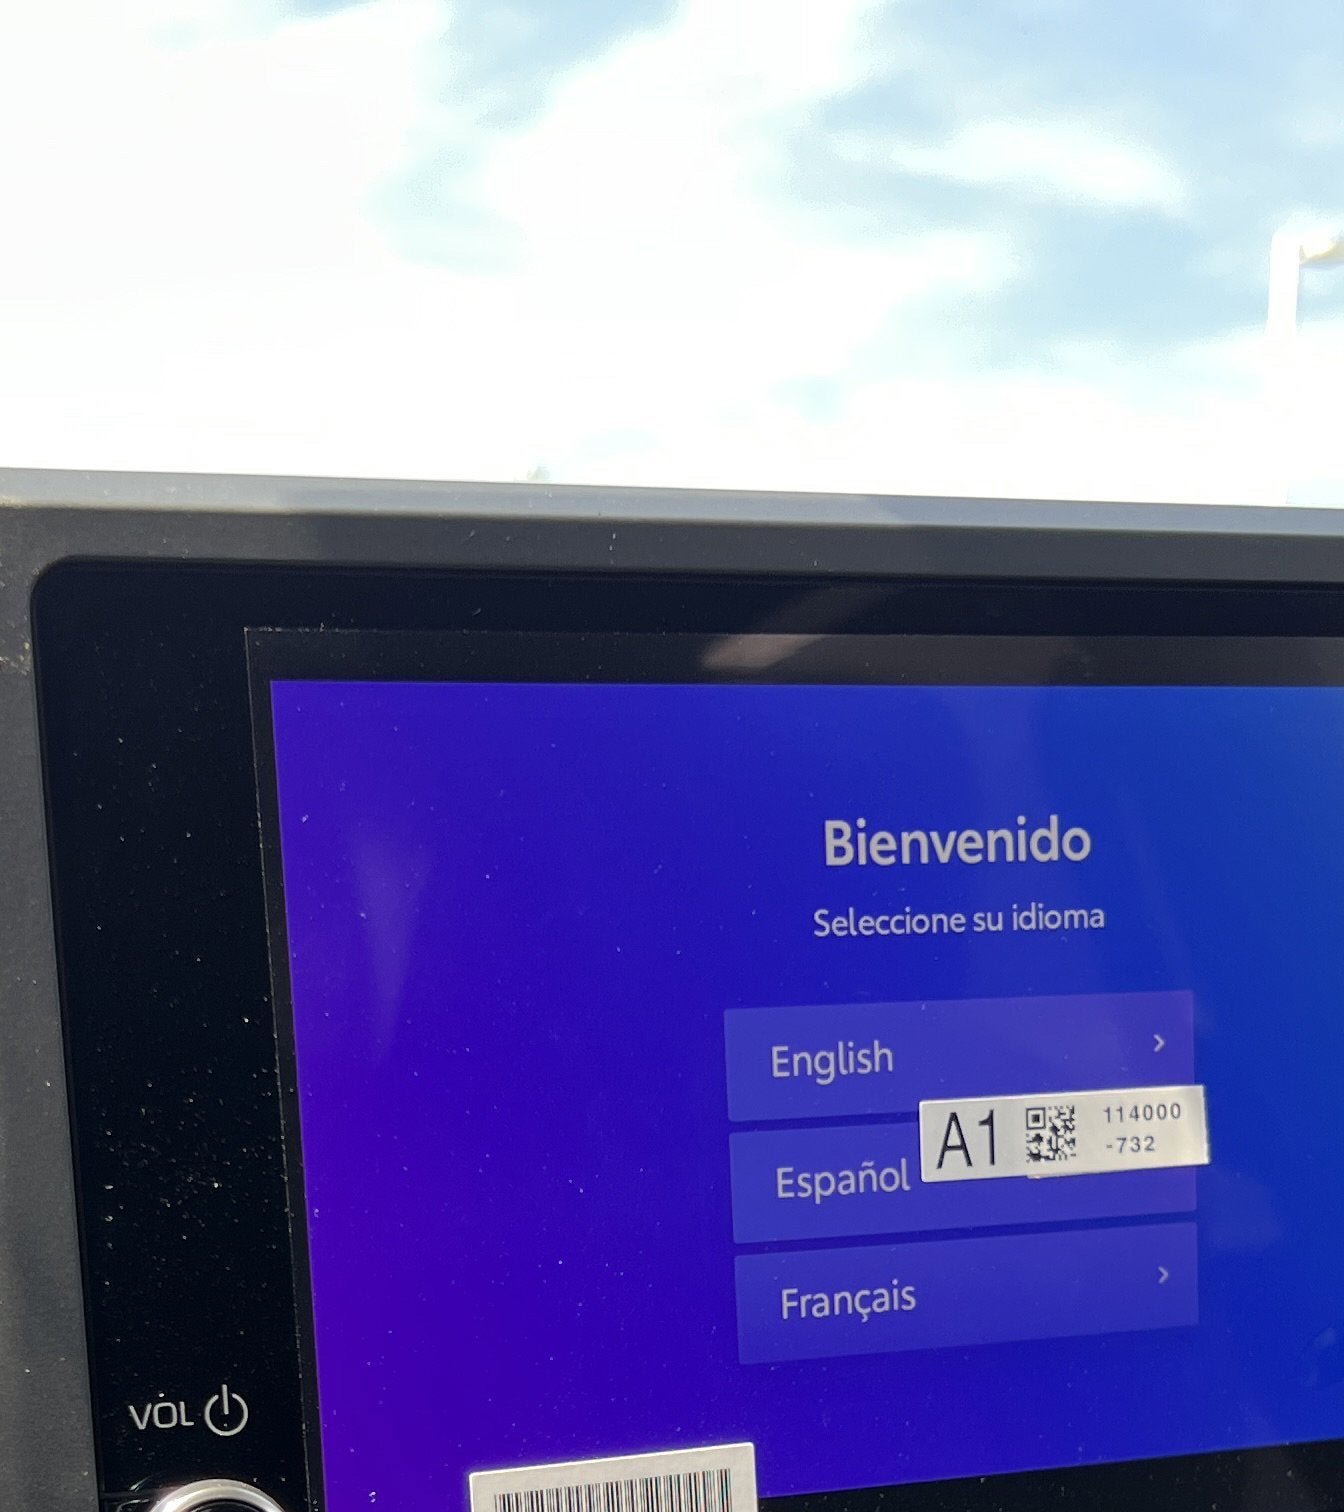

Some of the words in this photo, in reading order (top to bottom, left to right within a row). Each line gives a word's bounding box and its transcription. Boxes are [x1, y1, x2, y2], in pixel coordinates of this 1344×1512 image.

[824, 814, 1091, 866] Bienvenido
[814, 906, 966, 937] Seleccione
[973, 911, 1003, 933] su
[1012, 902, 1105, 930] idioma
[771, 1040, 894, 1086] English
[1103, 1102, 1182, 1122] 114000
[936, 1109, 997, 1169] A1
[1106, 1136, 1156, 1154] -732
[776, 1158, 911, 1204] Español
[780, 1278, 916, 1322] Français
[128, 1401, 194, 1430] VOL
